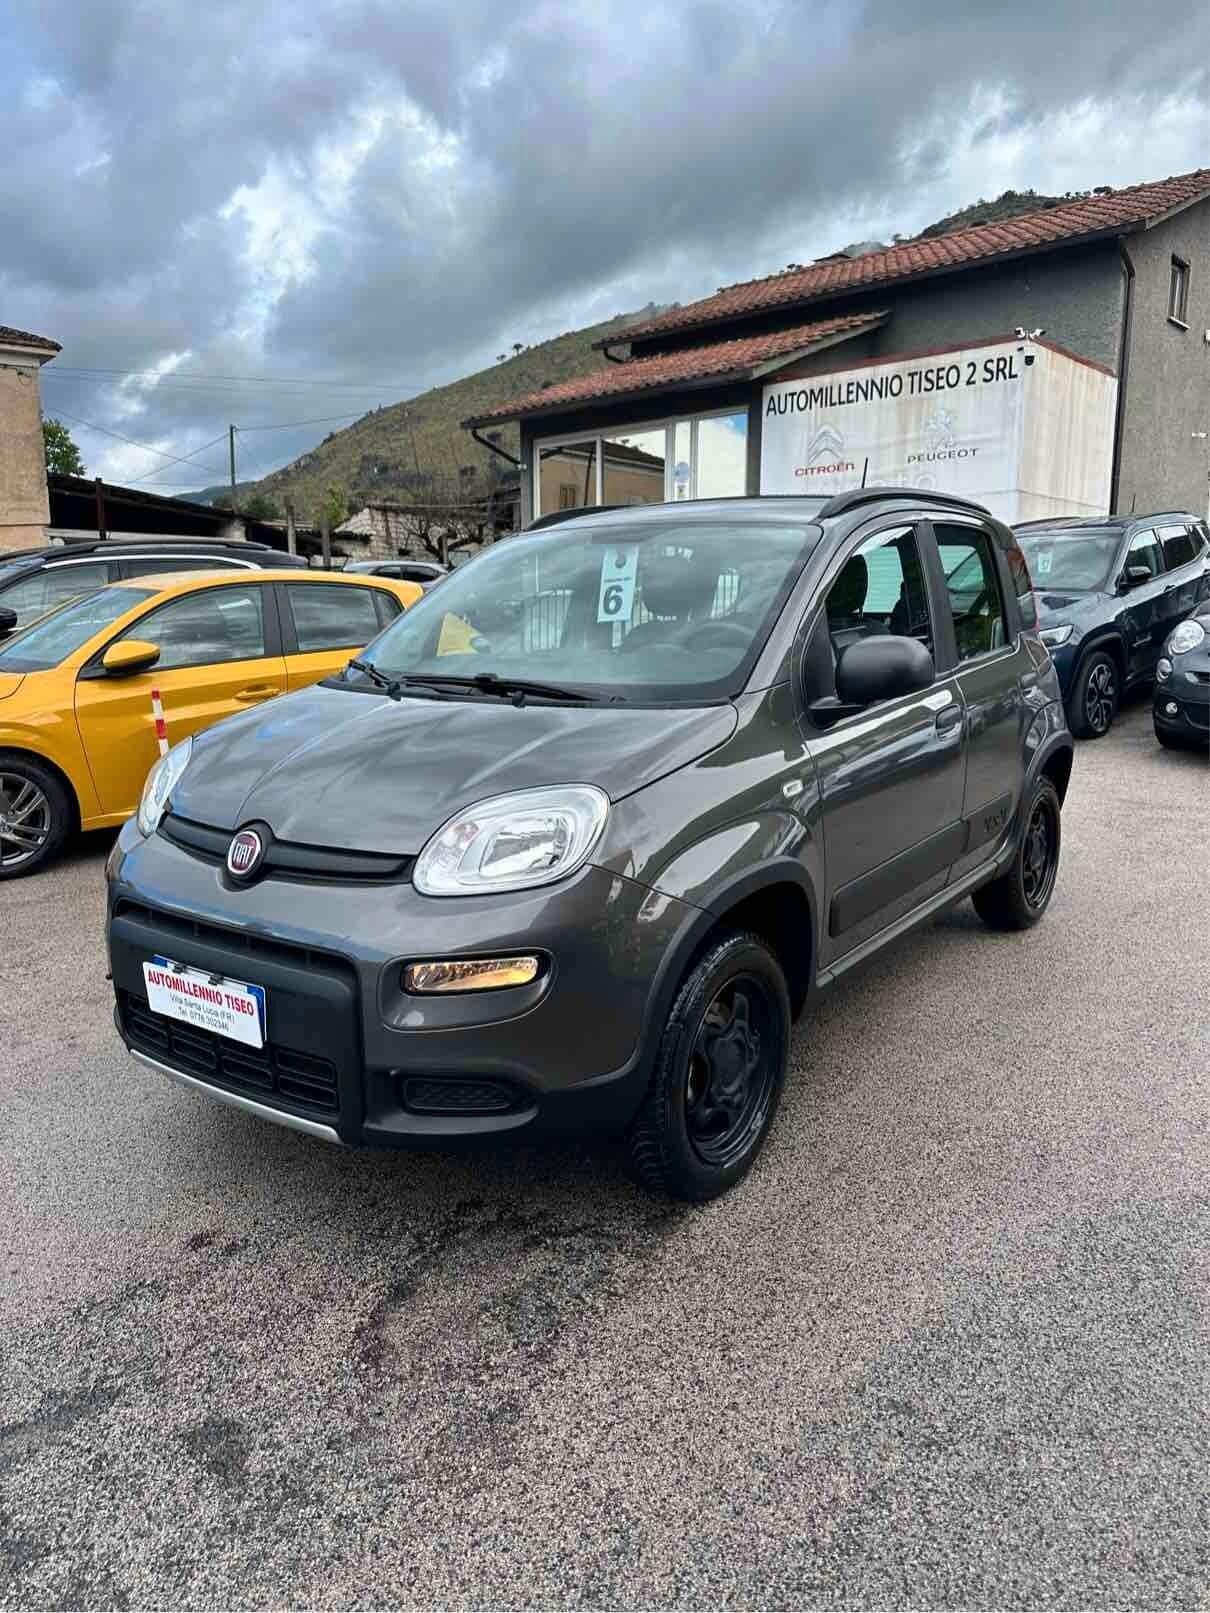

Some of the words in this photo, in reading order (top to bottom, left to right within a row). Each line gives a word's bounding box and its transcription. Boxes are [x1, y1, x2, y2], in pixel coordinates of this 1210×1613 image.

[766, 375, 903, 417] AUTOMILLENNIO
[908, 364, 960, 392] TISEO
[965, 362, 976, 386] 2
[983, 356, 1018, 383] SRL
[907, 448, 979, 464] PEUGEOT
[603, 585, 623, 615] 6
[233, 842, 254, 864] FIAT
[148, 969, 223, 1005] AUTOMILLENNIO
[225, 994, 255, 1017] TISEO
